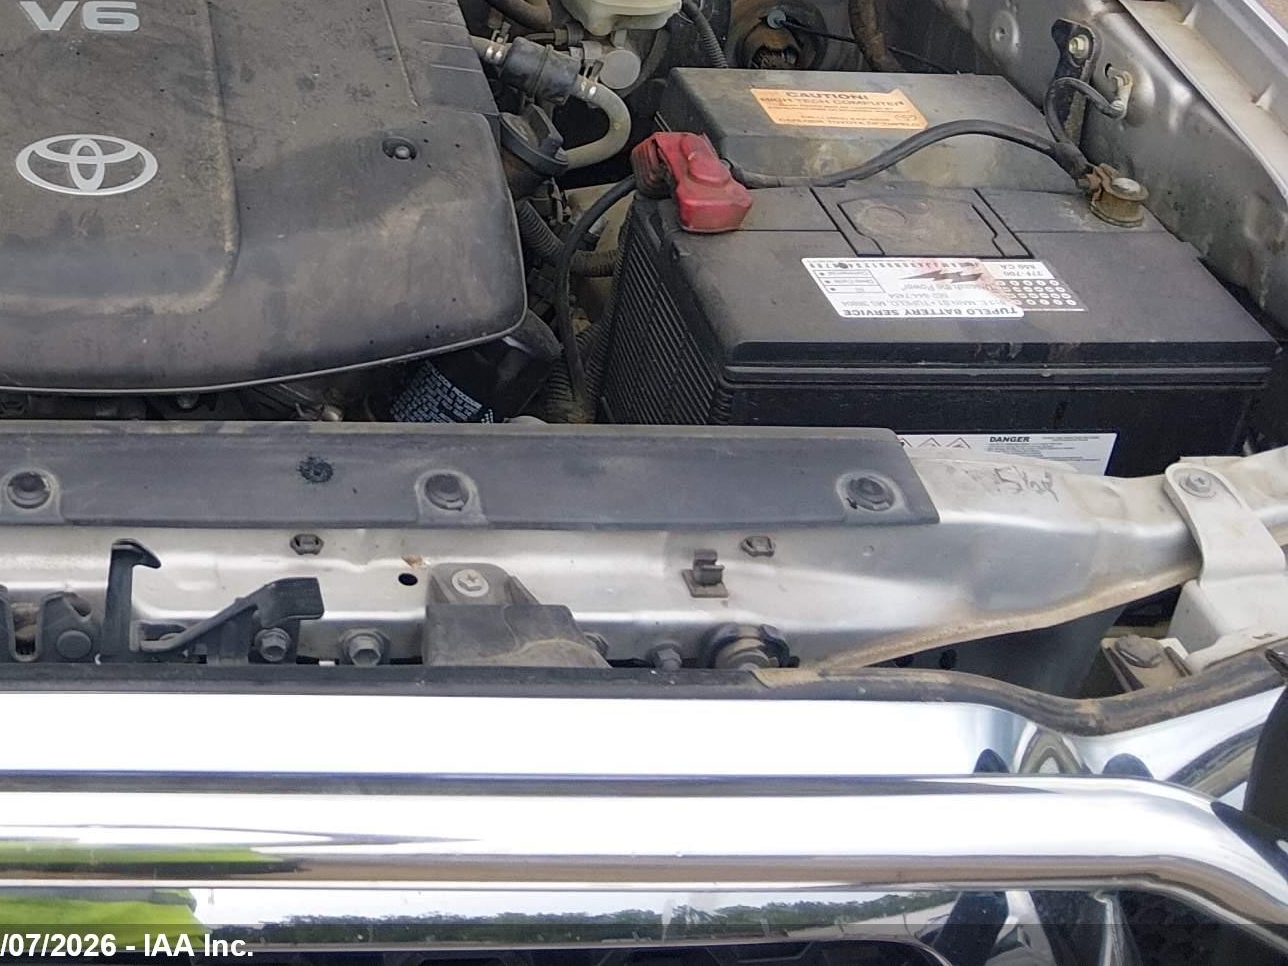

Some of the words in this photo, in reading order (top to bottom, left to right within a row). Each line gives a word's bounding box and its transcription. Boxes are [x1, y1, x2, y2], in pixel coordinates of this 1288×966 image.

[19, 0, 140, 32] V6
[785, 91, 869, 100] CAUTION!
[904, 308, 962, 316] BATTERY
[965, 307, 1018, 316] TUPELO
